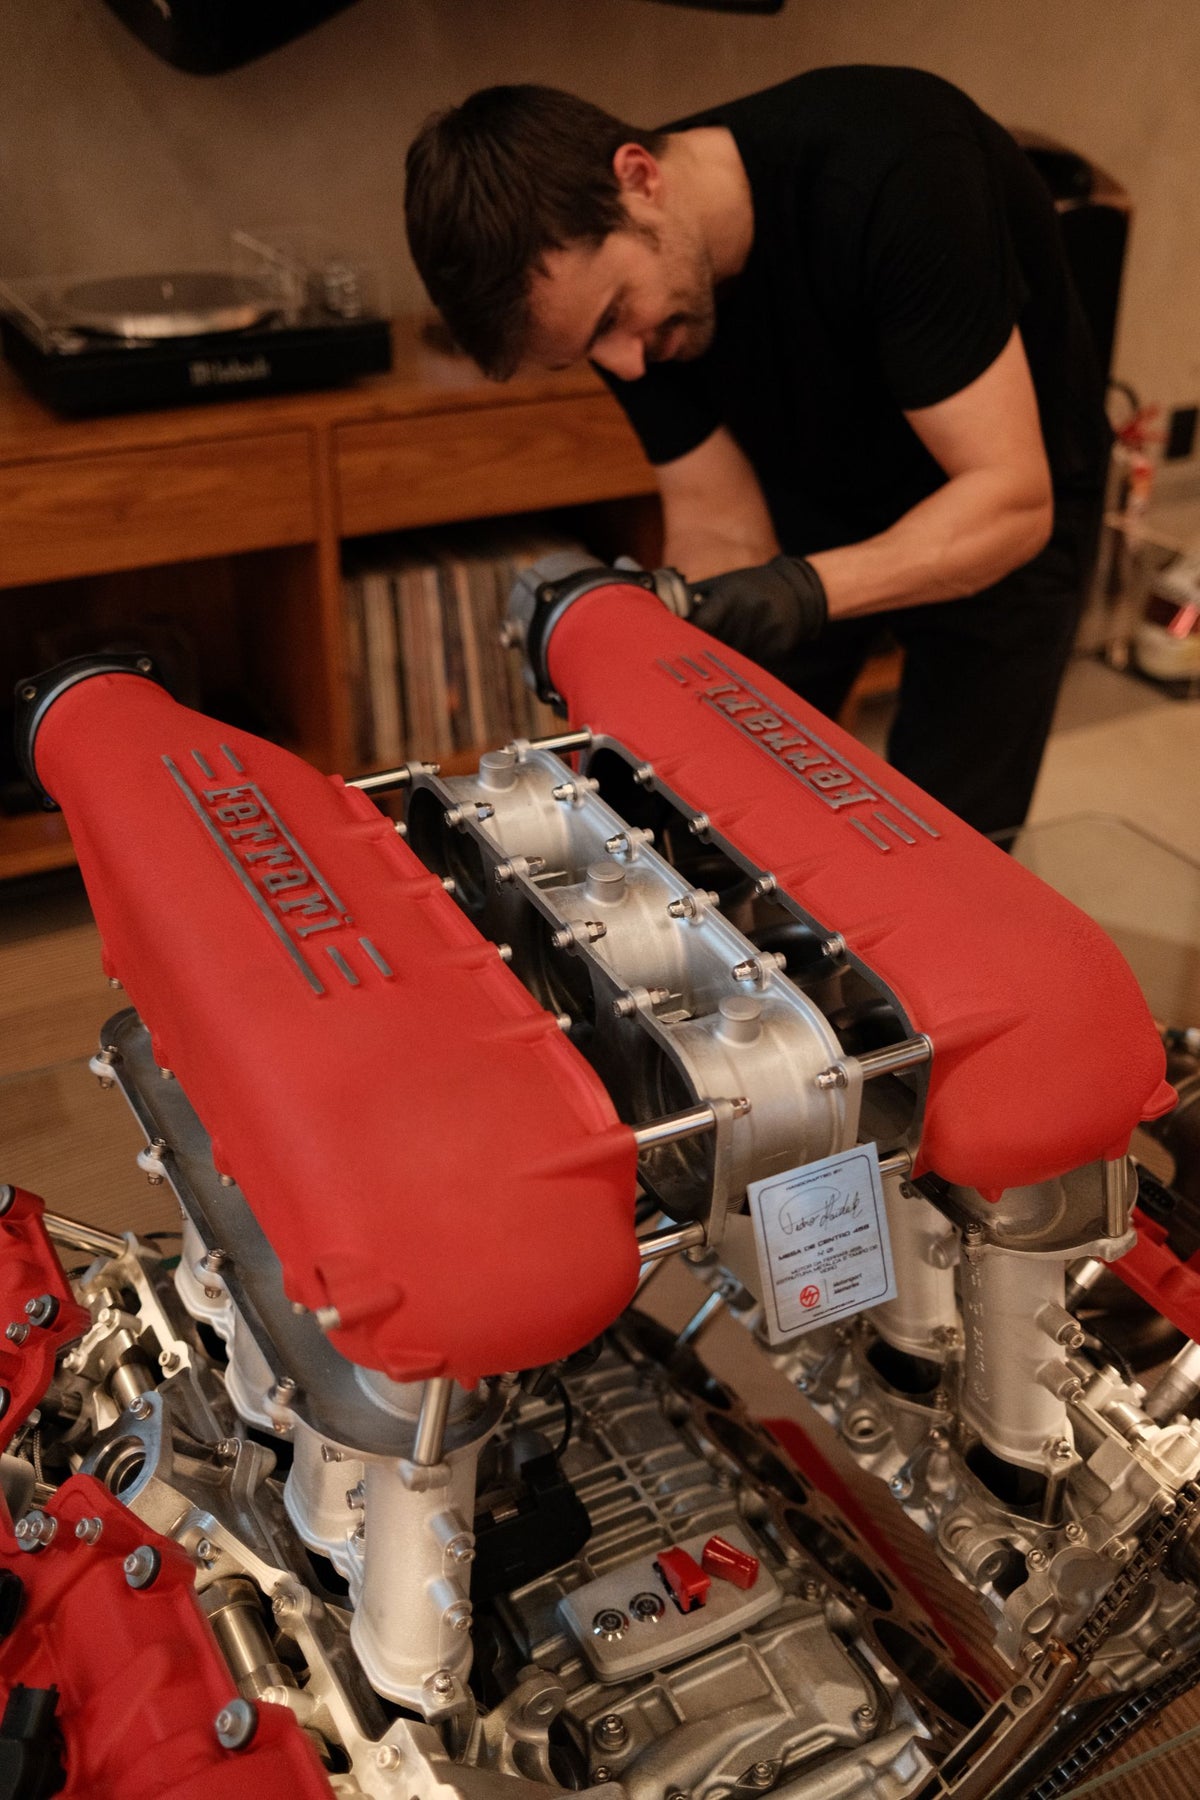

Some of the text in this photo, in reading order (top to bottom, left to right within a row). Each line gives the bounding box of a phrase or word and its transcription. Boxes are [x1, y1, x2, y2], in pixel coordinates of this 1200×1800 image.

[695, 683, 877, 809] Ferrari
[203, 782, 353, 938] Ferrari
[778, 1224, 869, 1261] MESA DE CENTRO 458
[833, 1273, 862, 1289] Motorsport
[834, 1282, 859, 1294] Memories
